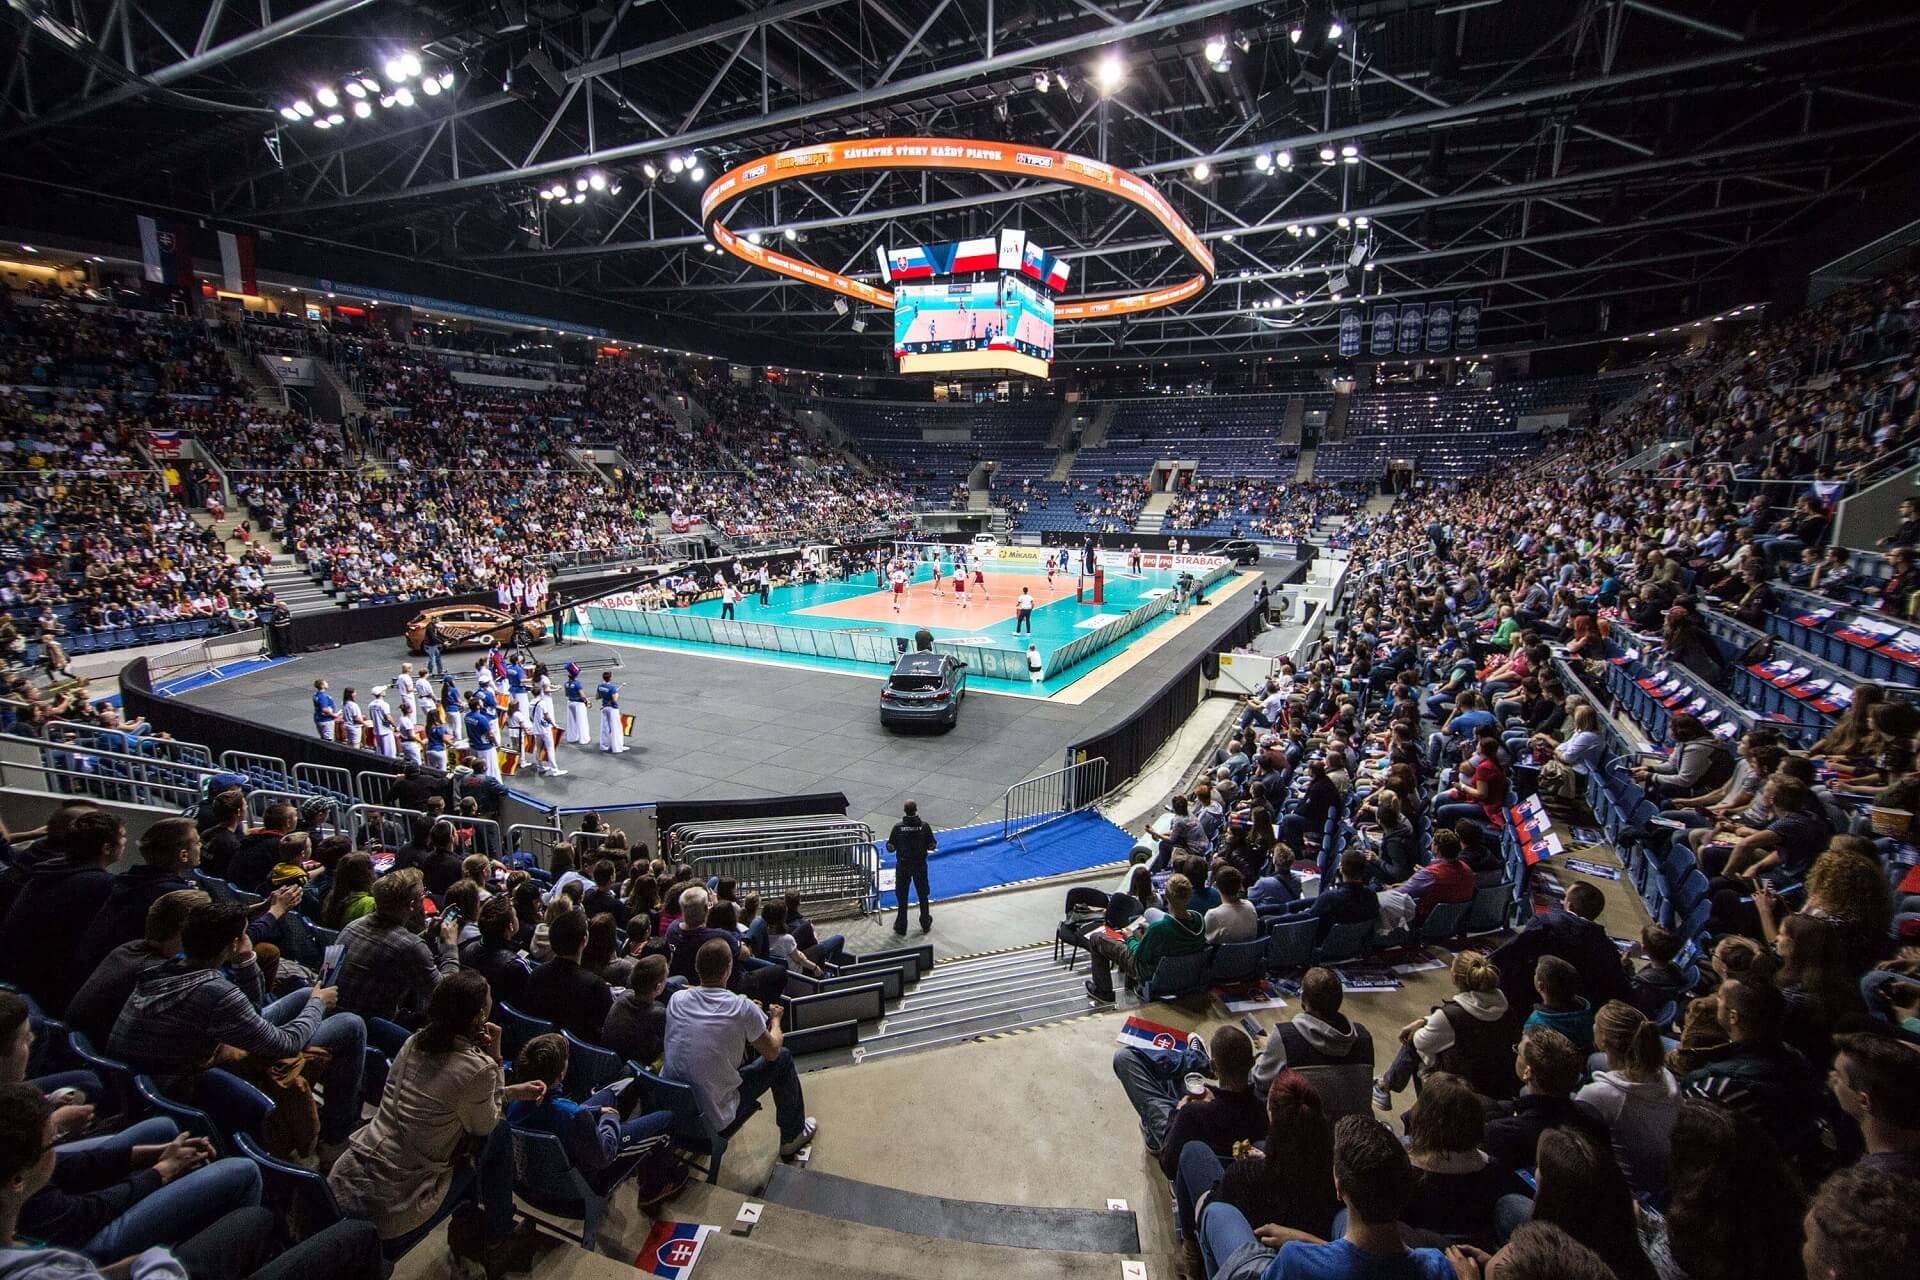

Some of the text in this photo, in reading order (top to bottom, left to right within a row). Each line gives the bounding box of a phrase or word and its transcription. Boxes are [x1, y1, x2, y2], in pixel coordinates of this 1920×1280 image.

[895, 145, 928, 156] VÝHRY
[931, 146, 964, 157] KAŽDÝ
[966, 149, 1002, 161] PIATOK
[921, 343, 928, 352] 9
[965, 339, 976, 350] 13
[1175, 555, 1222, 566] STRABAG
[578, 595, 633, 614] SABAG
